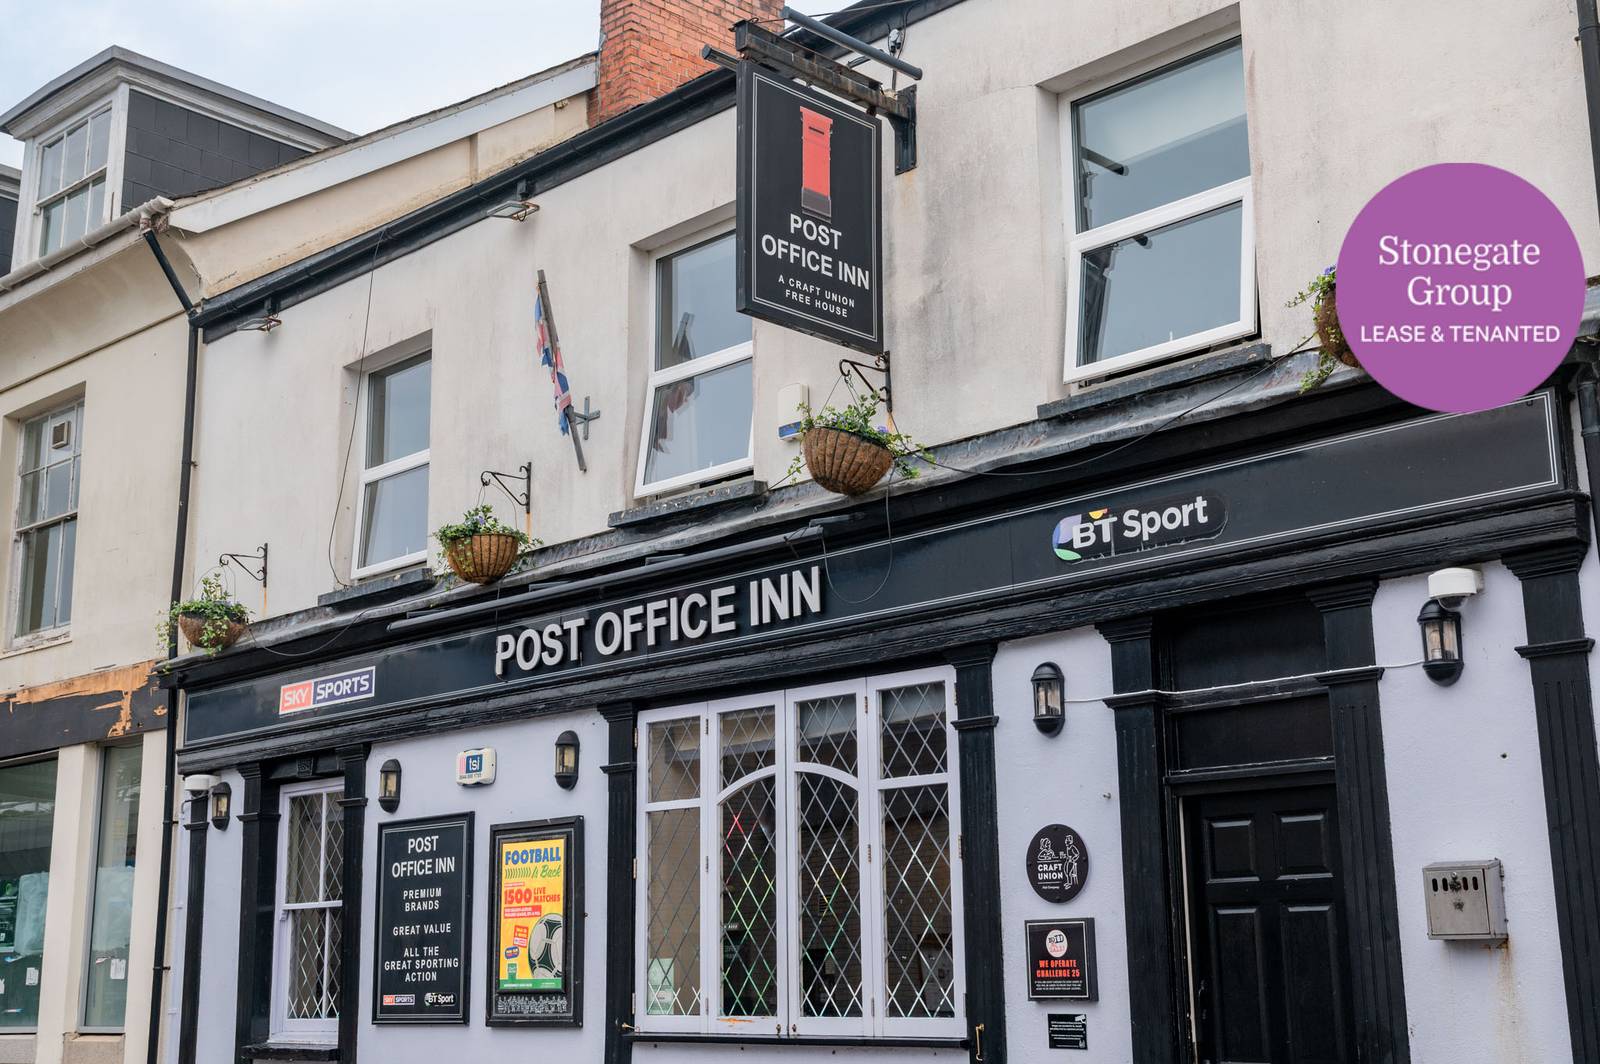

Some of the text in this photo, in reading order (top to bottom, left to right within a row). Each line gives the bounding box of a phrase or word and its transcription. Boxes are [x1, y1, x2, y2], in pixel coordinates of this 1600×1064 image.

[790, 213, 842, 250] POST
[762, 235, 870, 290] OFFICE INN
[778, 274, 855, 308] A CRAFT UNION
[785, 290, 848, 317] FREE HOUSE
[1072, 496, 1208, 549] BT Sport
[495, 565, 821, 675] POST OFFICE INN
[283, 674, 369, 707] SKY SPORTS
[408, 836, 439, 854] POST
[505, 847, 561, 865] FOOTBALL
[392, 857, 455, 878] OFFICE INN
[540, 864, 561, 878] Back
[1037, 863, 1062, 872] CRAFT
[1038, 872, 1063, 880] UNION
[403, 888, 442, 900] PREMIUM
[503, 887, 532, 904] 1500
[534, 886, 546, 895] LIVE
[534, 894, 561, 904] MATCHES
[405, 900, 440, 912] BRANDS
[393, 923, 451, 936] GREAT VALUE
[404, 946, 439, 957] ALL THE
[385, 958, 459, 971] GREAT SPORTING
[1039, 959, 1077, 968] WE OPERATE
[405, 971, 437, 982] ACTION
[1036, 969, 1081, 978] CHALLENGE 25
[428, 994, 454, 1004] BT Sport
